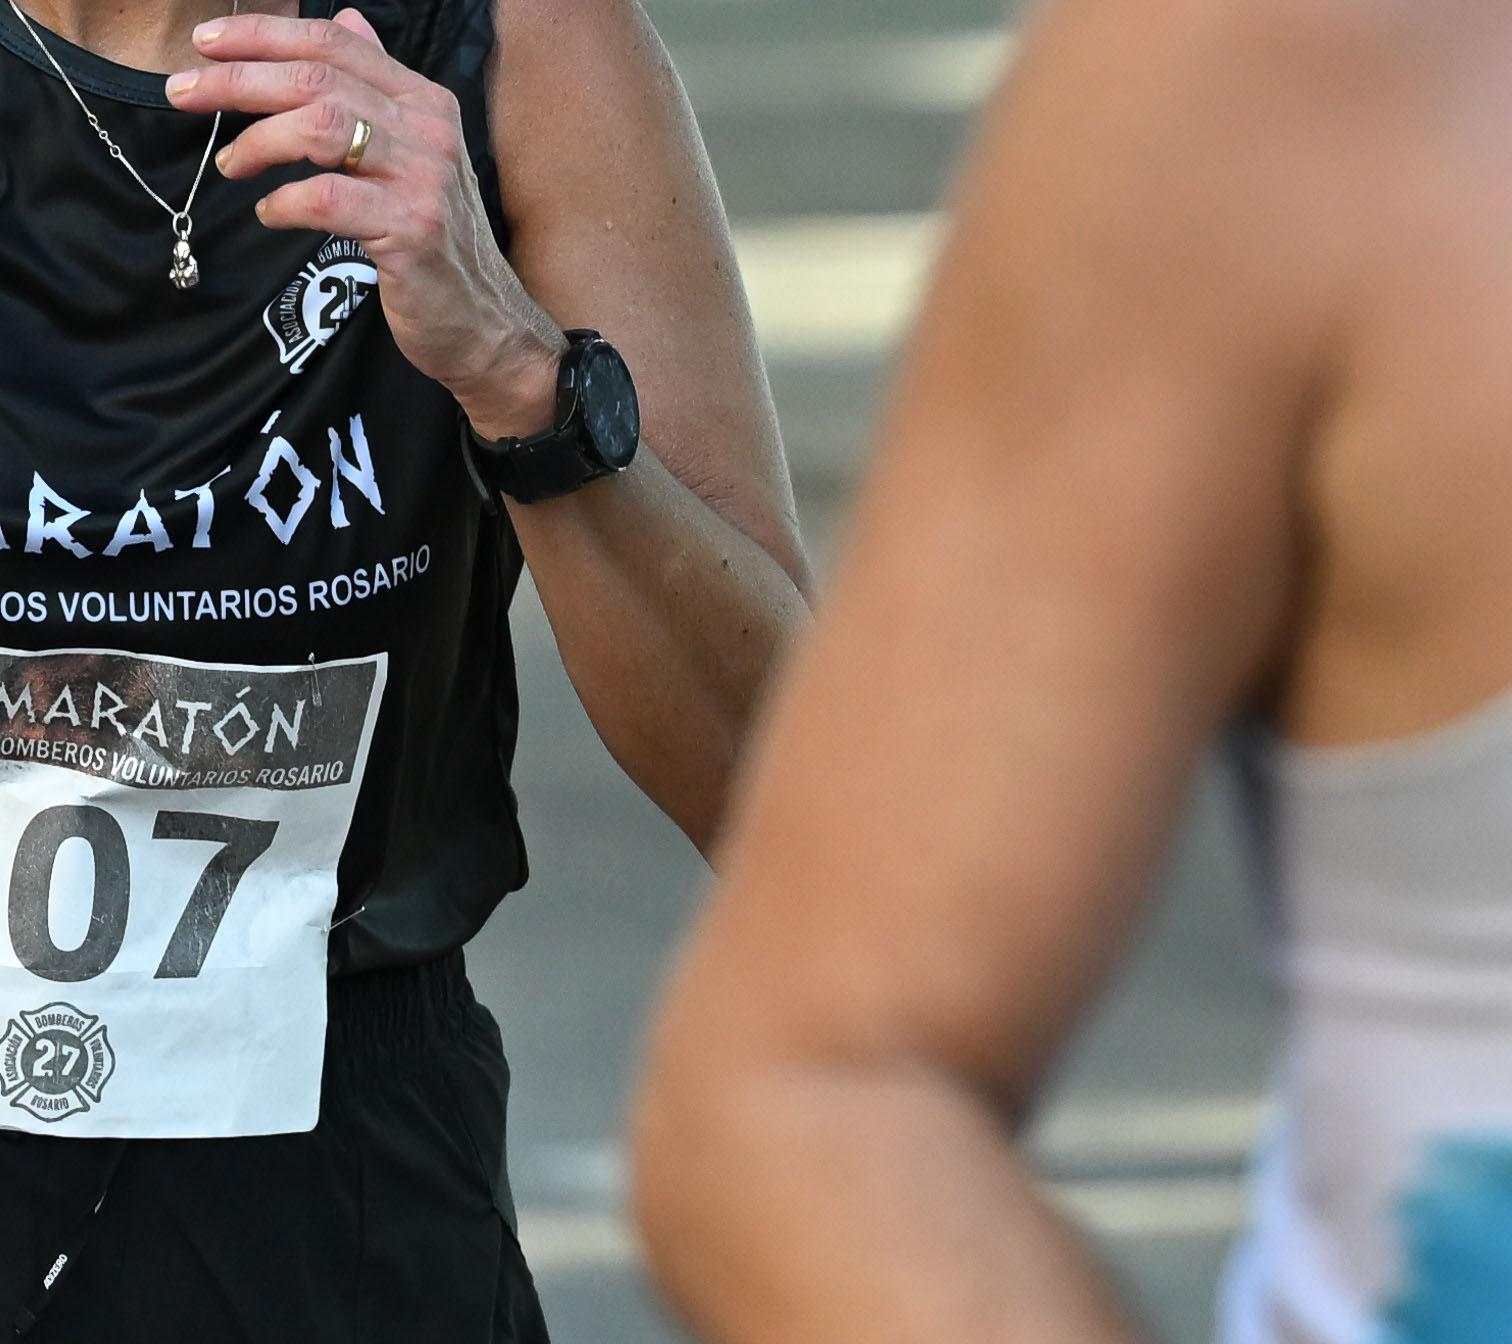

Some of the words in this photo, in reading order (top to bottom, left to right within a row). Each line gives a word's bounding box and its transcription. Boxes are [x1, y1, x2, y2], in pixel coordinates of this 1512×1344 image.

[58, 583, 298, 624] VOLUNTARIOS
[308, 544, 431, 612] ROSARIO
[111, 751, 253, 788] VOLUNTARIOS
[255, 760, 345, 788] ROSARIO
[32, 1037, 81, 1077] 27
